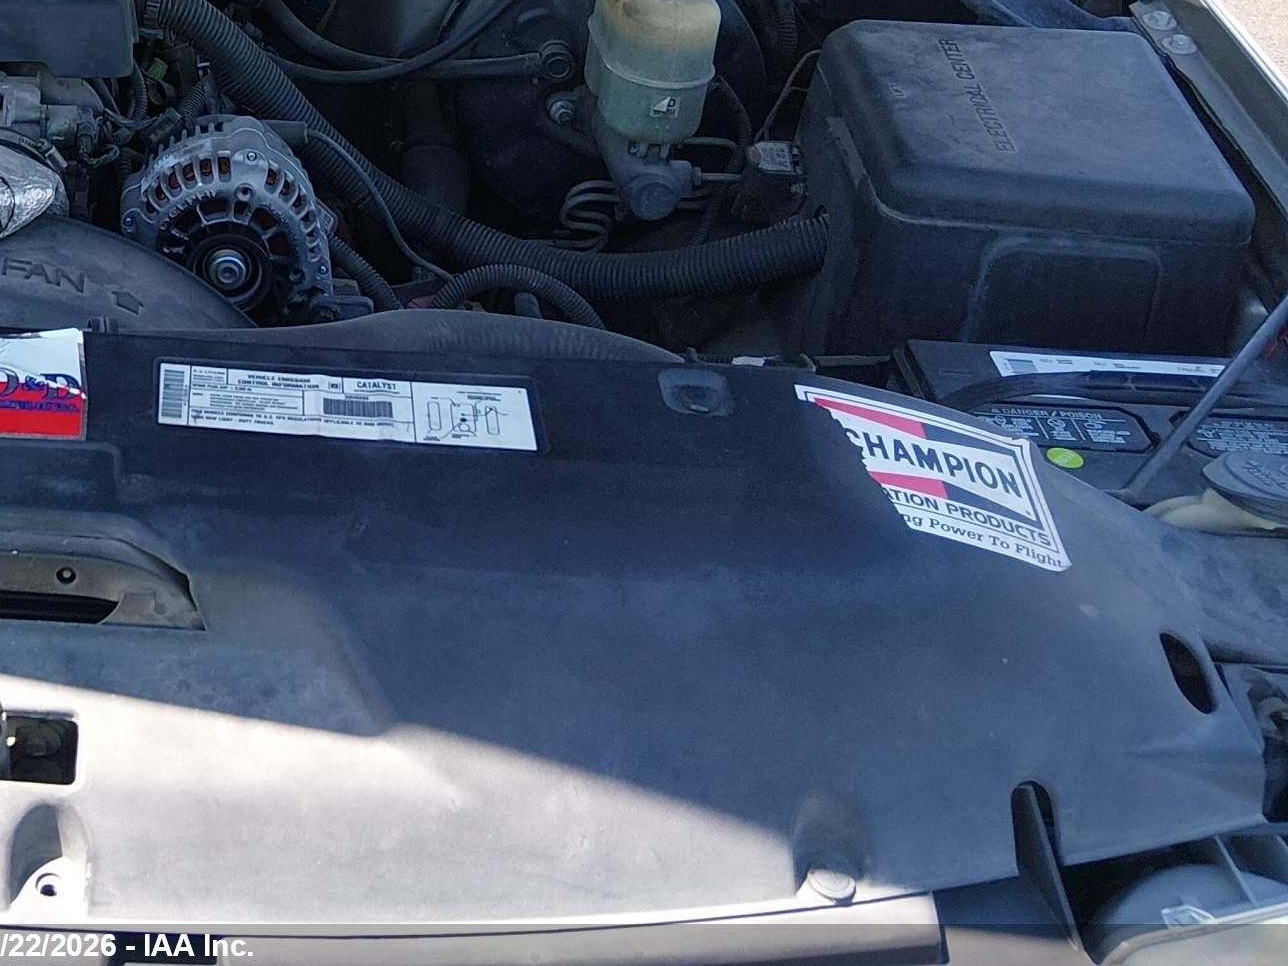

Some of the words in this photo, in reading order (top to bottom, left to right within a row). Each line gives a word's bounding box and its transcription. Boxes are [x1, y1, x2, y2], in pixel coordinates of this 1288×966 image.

[938, 37, 976, 81] CENTER
[963, 82, 1018, 153] ELECTRICAL
[0, 257, 90, 294] FAN
[356, 381, 397, 392] CATALYST
[1002, 408, 1049, 418] DANGER
[1058, 410, 1104, 420] POISON
[928, 518, 986, 543] Power
[987, 534, 1011, 550] To
[1014, 544, 1065, 569] Flight
[945, 501, 1053, 548] PRODUCTS
